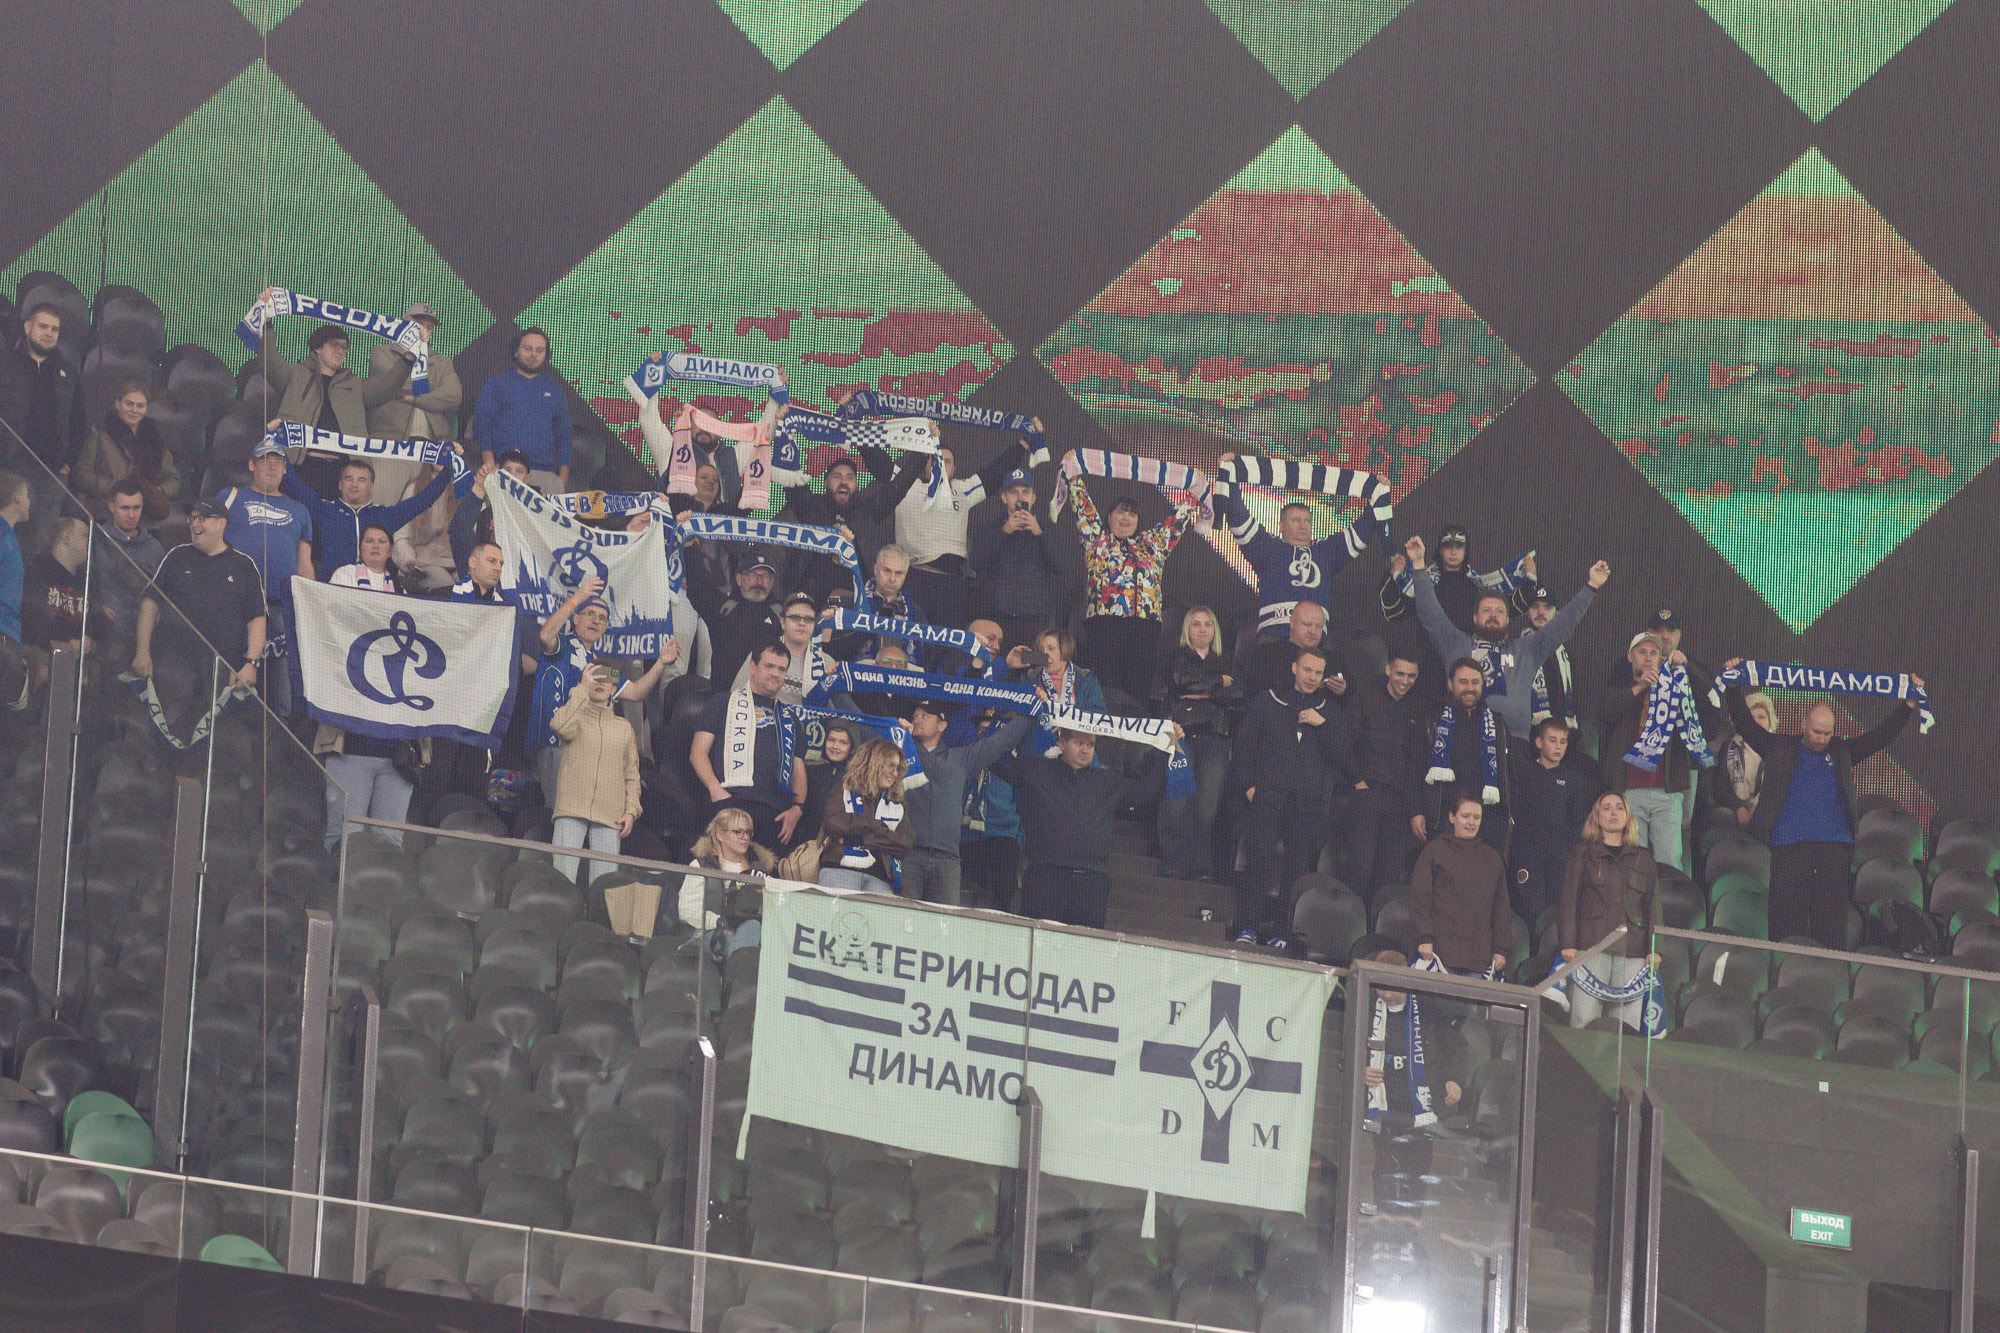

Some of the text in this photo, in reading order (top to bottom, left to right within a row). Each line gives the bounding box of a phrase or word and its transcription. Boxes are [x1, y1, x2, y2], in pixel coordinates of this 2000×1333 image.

[295, 294, 402, 337] FCDM
[684, 357, 775, 379] ДИНАМО
[312, 428, 415, 457] FCDM
[498, 470, 544, 514] THIS
[518, 593, 545, 613] THE
[617, 633, 655, 655] SINCE
[851, 612, 966, 646] ДИНАМО
[853, 671, 1037, 705] ОДНА ЖИЗНЬ ОДНА КОМАНДА!
[1762, 665, 1893, 694] ДИНАМО
[1078, 723, 1115, 735] МОСКВА
[907, 1001, 961, 1042] ЗА
[1167, 1000, 1288, 1042] F C
[848, 1042, 1024, 1105] ДИНАМО
[1159, 1108, 1281, 1151] D M
[1801, 1212, 1845, 1230] ВЫХОД
[1810, 1229, 1834, 1242] EXIT
